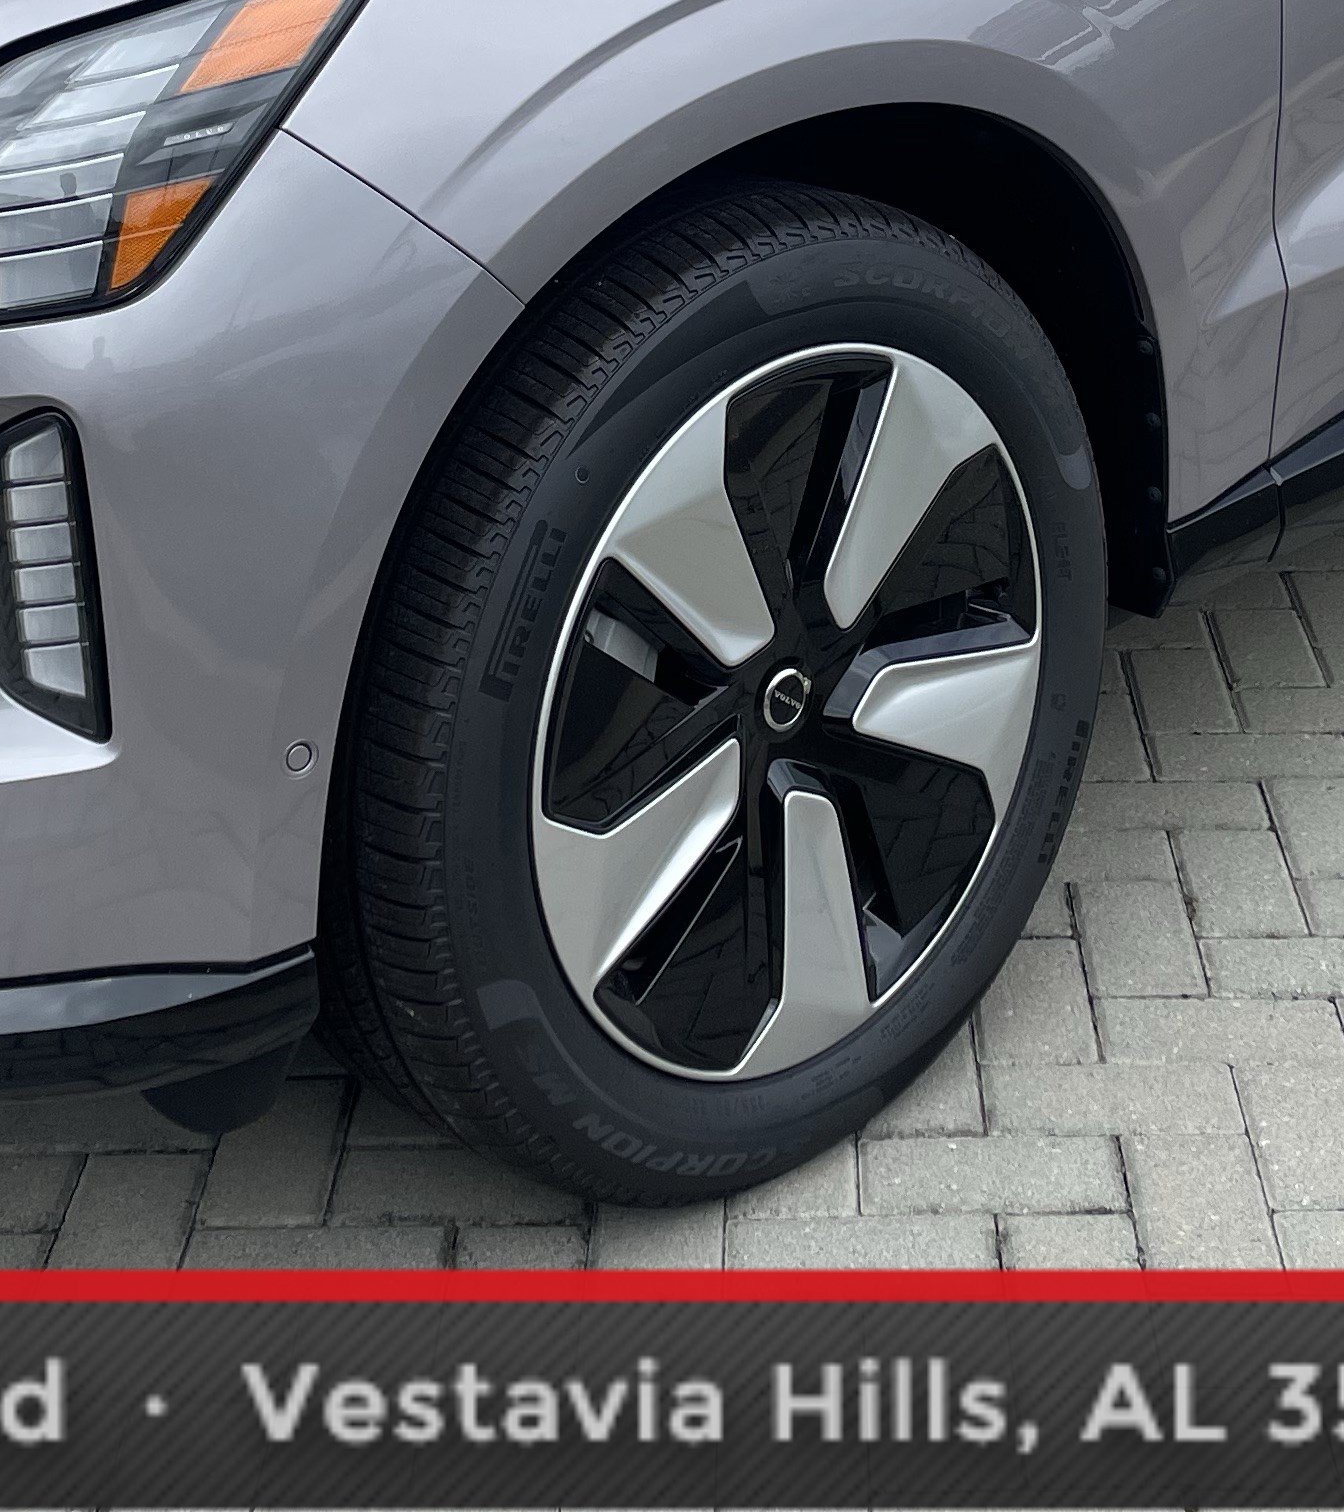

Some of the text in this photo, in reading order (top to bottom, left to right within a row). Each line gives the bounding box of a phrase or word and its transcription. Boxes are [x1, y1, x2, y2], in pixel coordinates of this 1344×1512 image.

[173, 125, 225, 142] OLVO
[478, 517, 567, 702] PIRELLI
[774, 689, 803, 710] VOLVO
[1038, 717, 1090, 867] PIRELLI
[572, 1104, 782, 1178] CORPION
